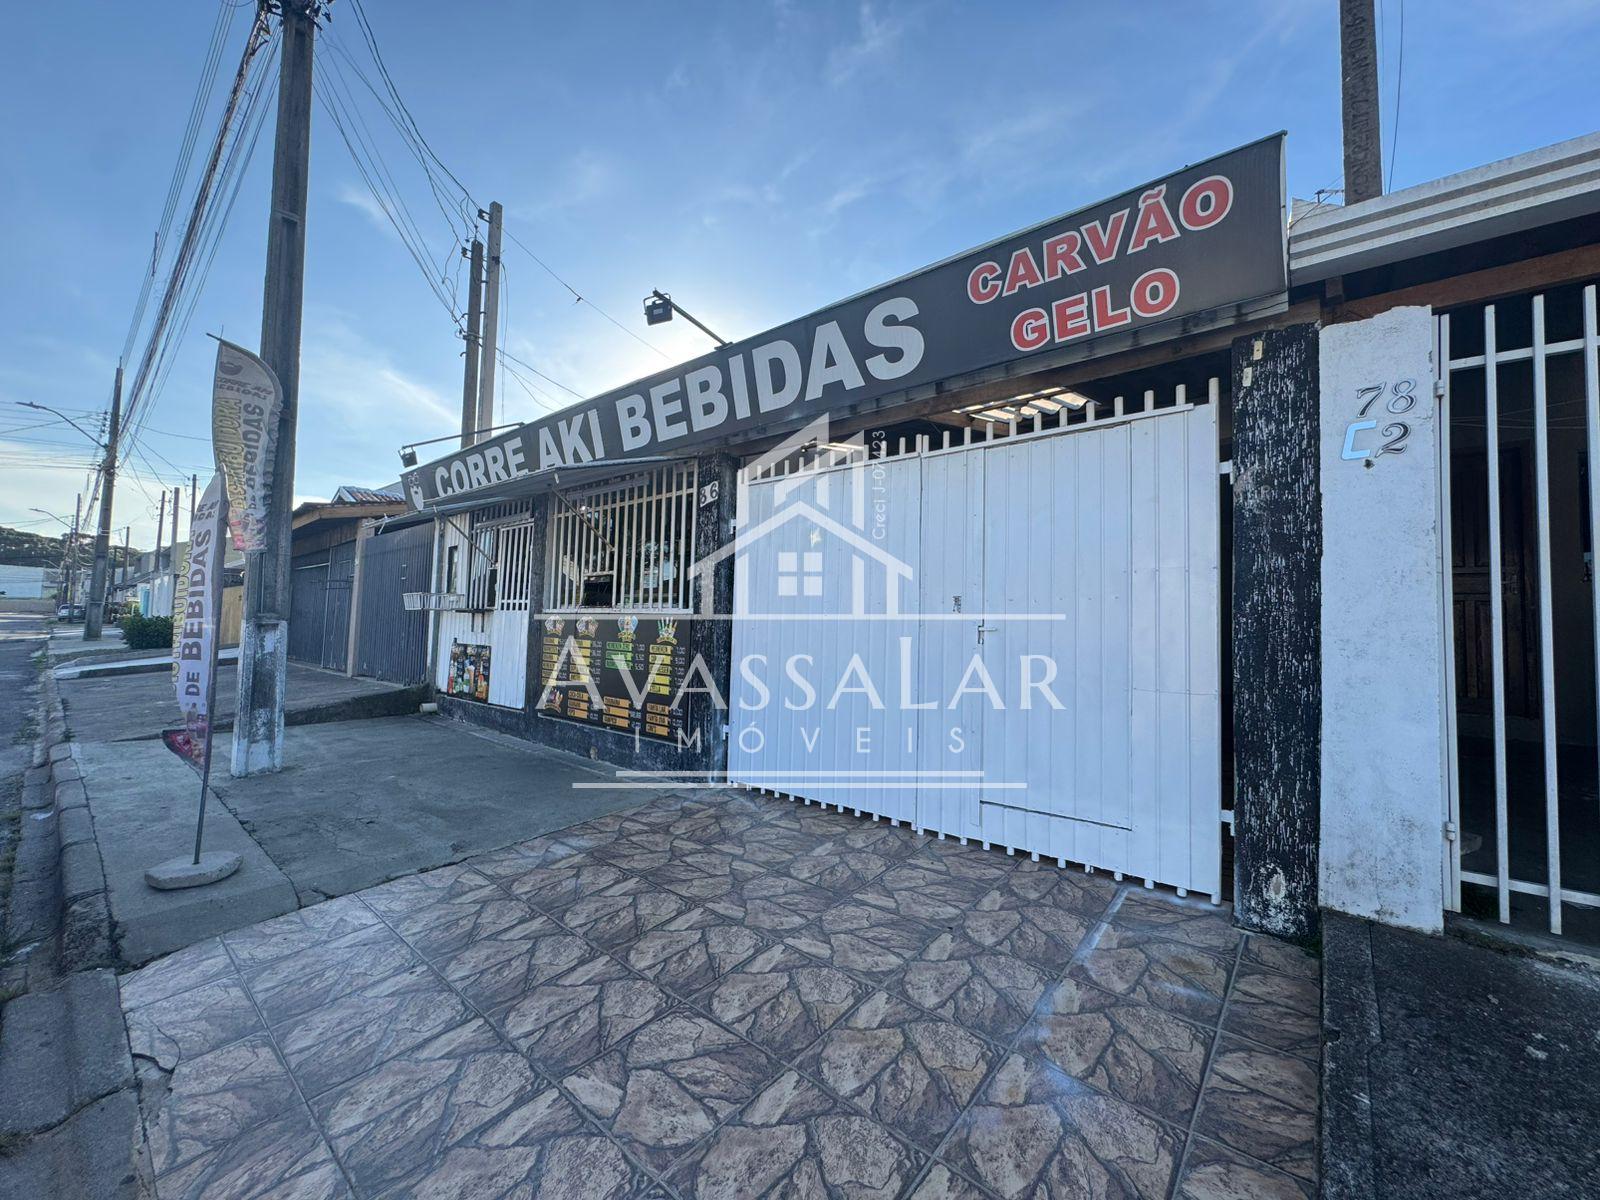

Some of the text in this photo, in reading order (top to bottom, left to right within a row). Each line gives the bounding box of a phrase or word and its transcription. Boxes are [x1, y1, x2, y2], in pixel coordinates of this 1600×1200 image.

[967, 175, 1233, 304] CARVÃO
[1010, 268, 1180, 352] GELO
[435, 297, 926, 498] CORRE AKI BEBIDAS
[1354, 377, 1417, 418] 78
[700, 482, 719, 505] 86
[181, 529, 212, 661] BEBIDAS
[185, 671, 200, 697] DE
